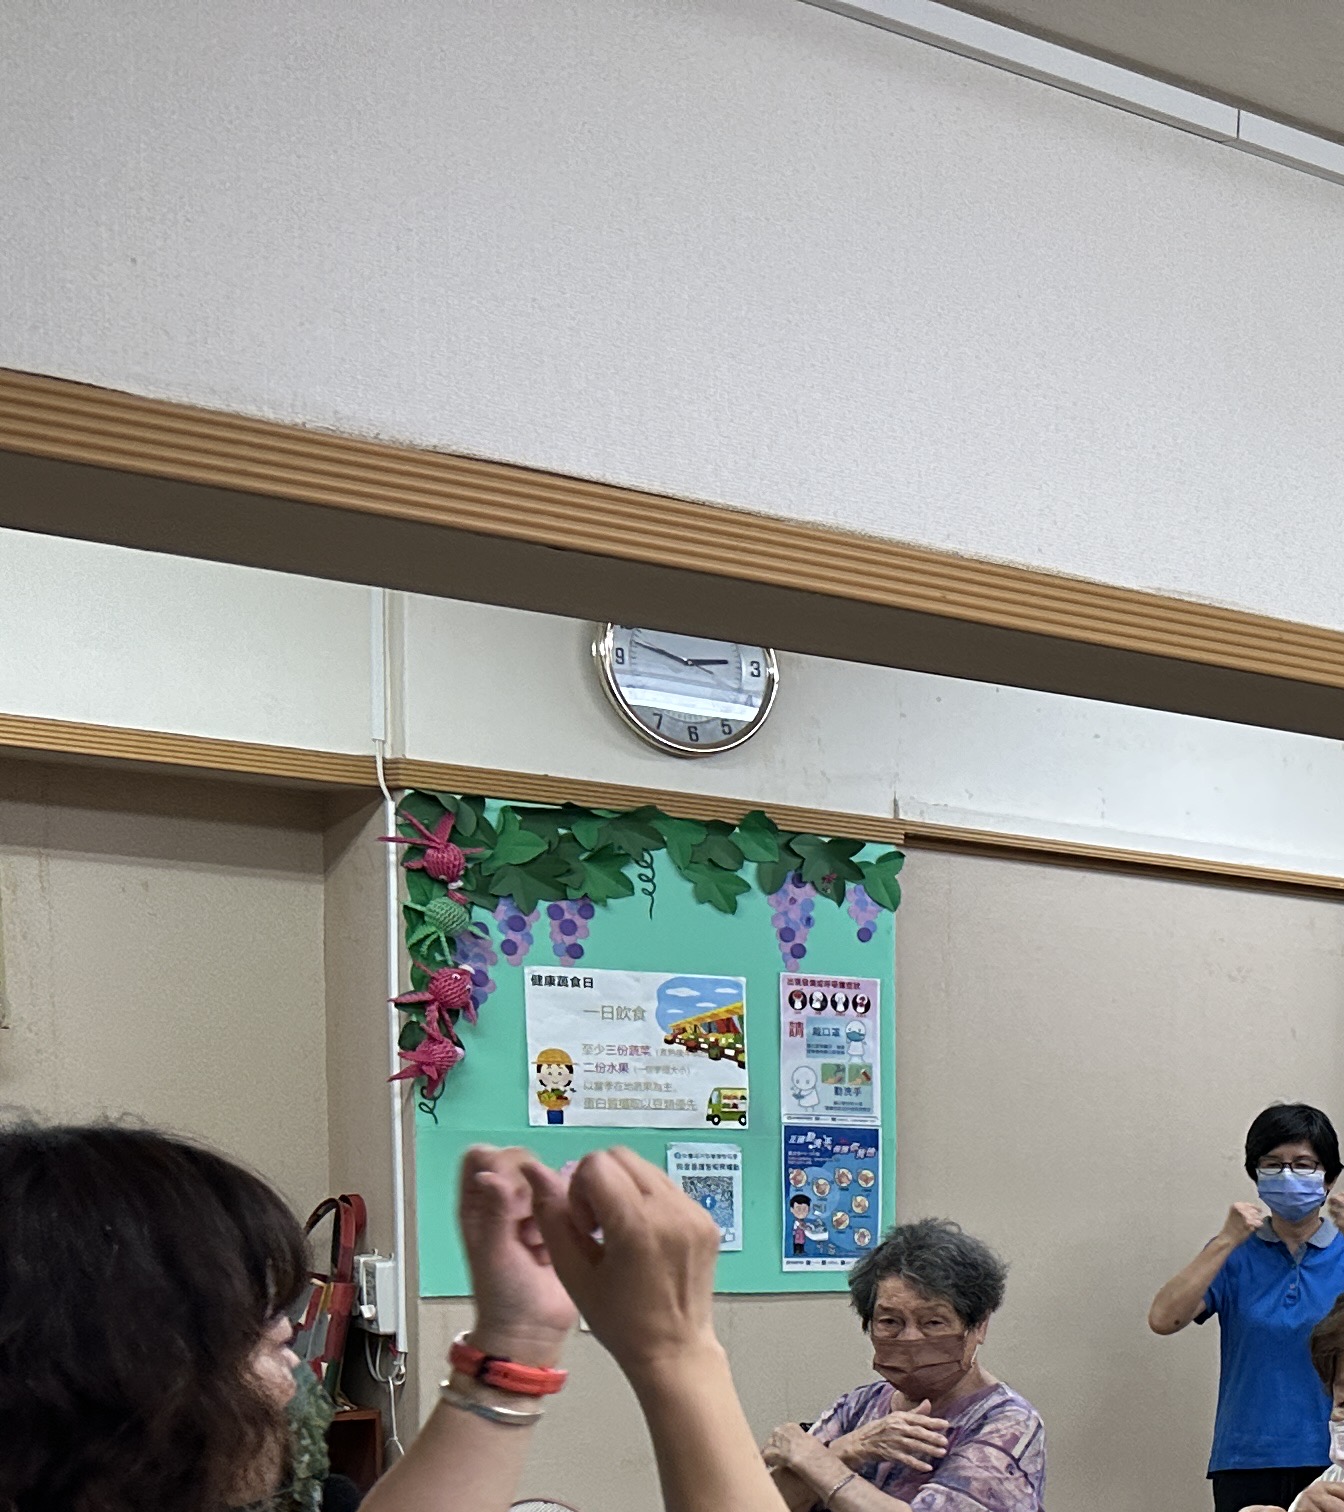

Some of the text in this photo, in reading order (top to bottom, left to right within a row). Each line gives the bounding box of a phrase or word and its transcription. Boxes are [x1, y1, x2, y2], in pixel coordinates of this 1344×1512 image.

[615, 647, 625, 665] 9
[750, 660, 761, 678] 3
[652, 712, 663, 730] 7
[721, 718, 733, 735] 5
[687, 725, 699, 742] 6
[583, 1005, 647, 1022] 一日飲食
